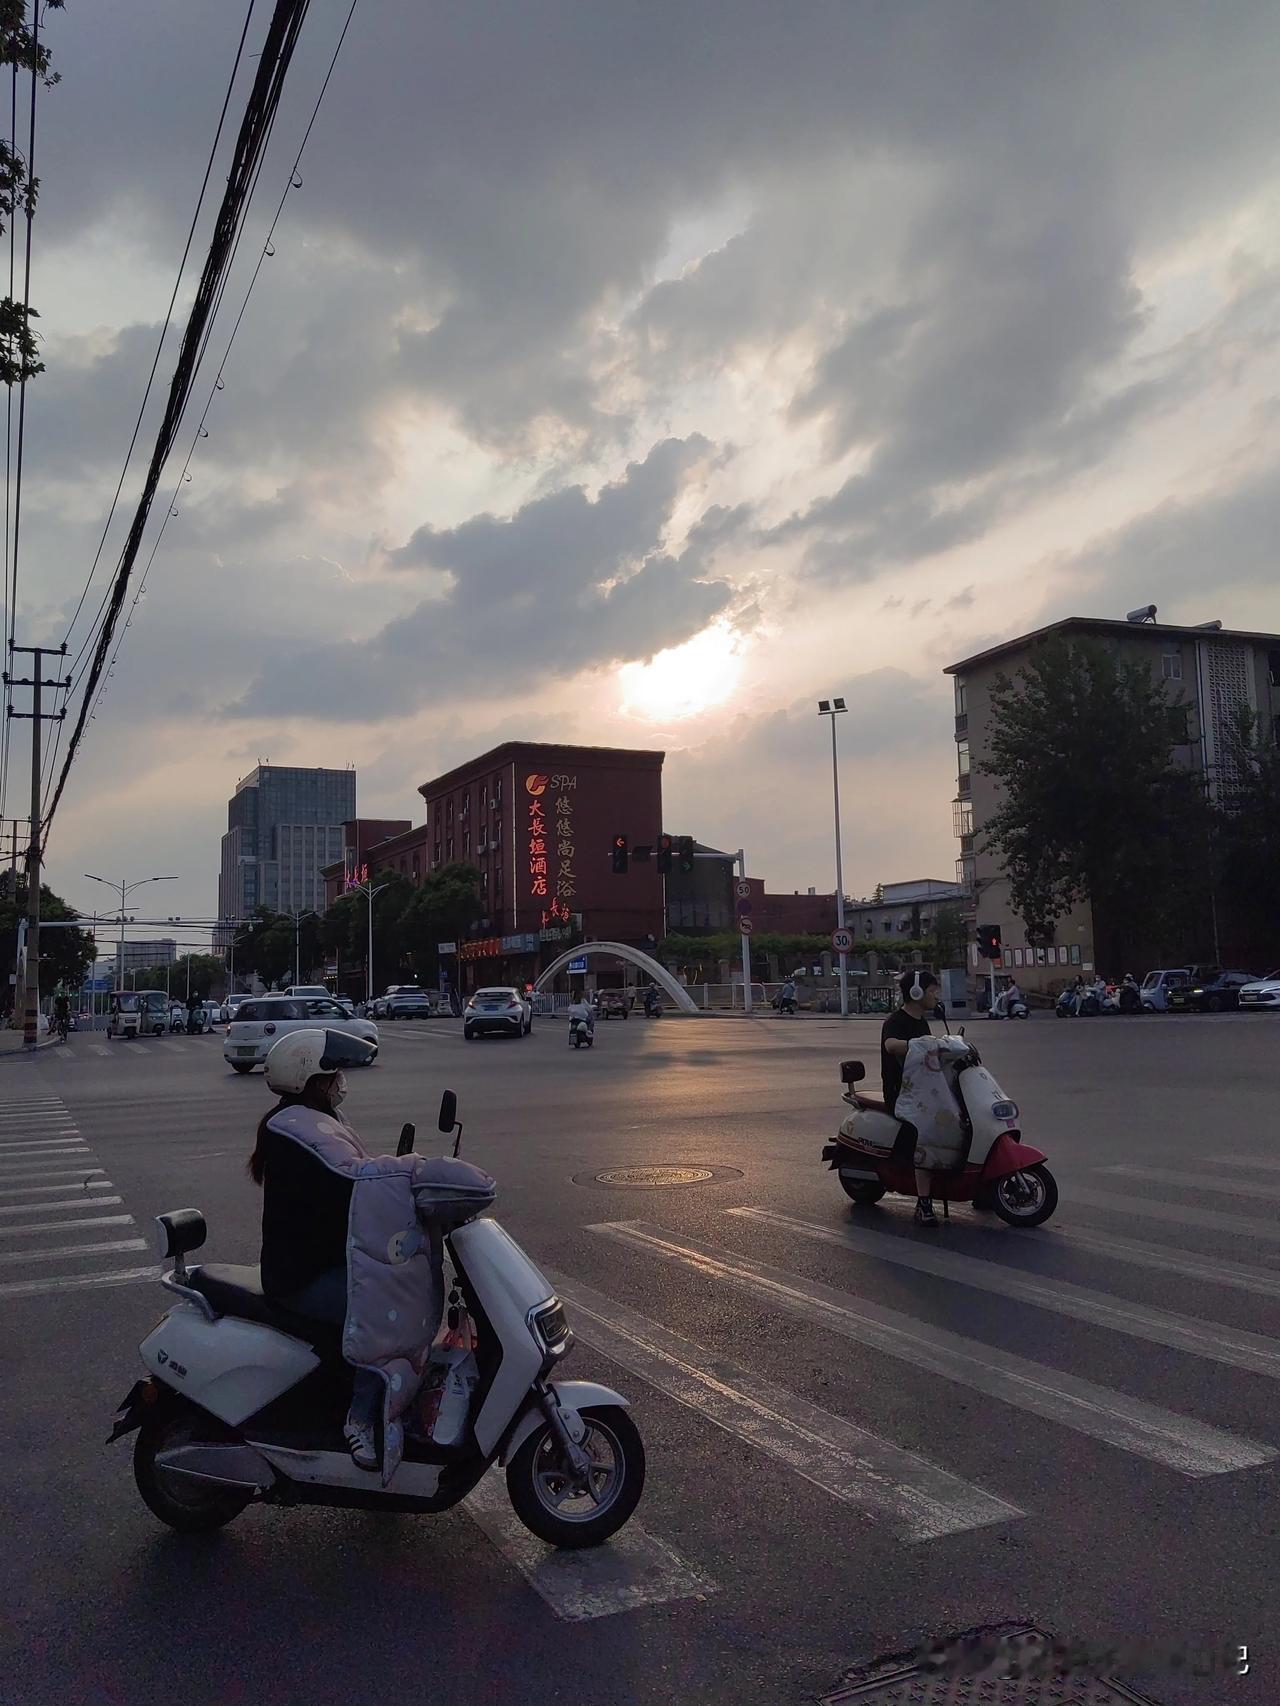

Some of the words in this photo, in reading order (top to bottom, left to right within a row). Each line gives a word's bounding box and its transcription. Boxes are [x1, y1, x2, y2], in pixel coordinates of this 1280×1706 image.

[551, 774, 577, 791] SPA
[528, 800, 548, 895] 大長垣酒店
[555, 796, 577, 897] 悠悠尚足浴
[835, 935, 848, 946] 30
